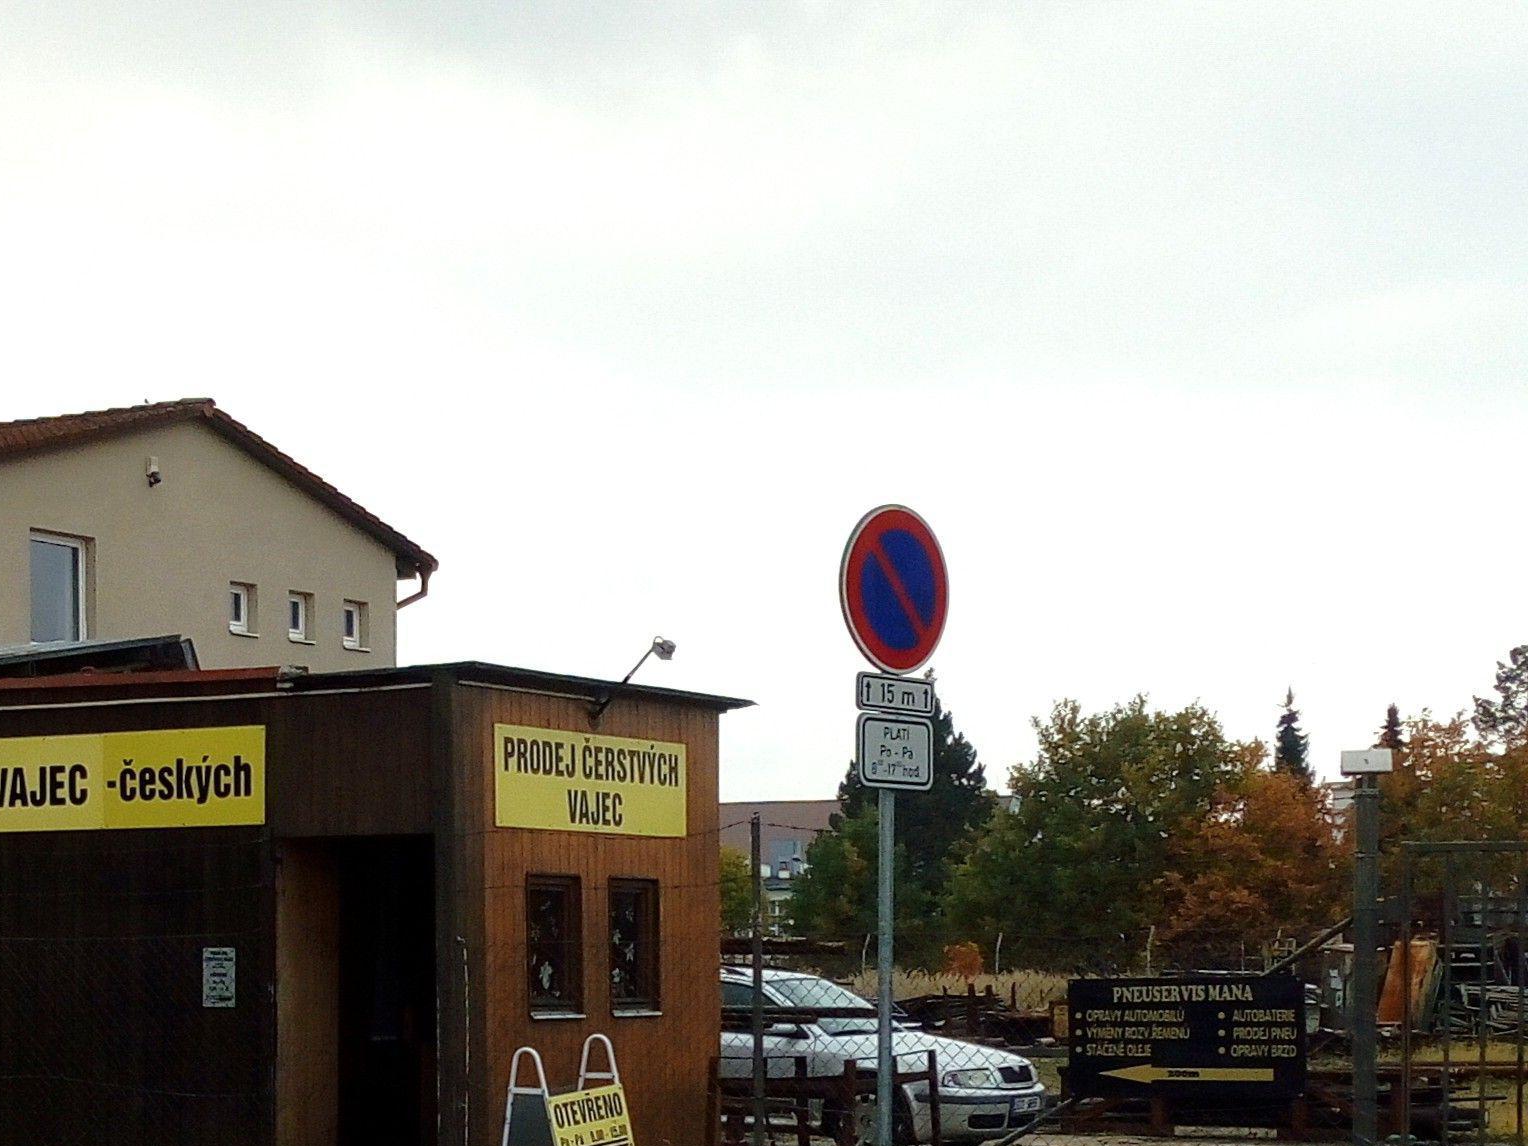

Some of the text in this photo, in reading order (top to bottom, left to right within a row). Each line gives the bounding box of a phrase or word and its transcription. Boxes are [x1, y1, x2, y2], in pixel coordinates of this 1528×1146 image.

[880, 683, 915, 706] 15 m
[880, 744, 892, 758] Po
[504, 736, 679, 787] PRODEJ ČERSTVÝCH
[567, 789, 623, 827] VAJEC
[1113, 984, 1254, 1003] PNEUSERVIS MANA
[1085, 1009, 1122, 1022] OPRAVY
[1232, 1009, 1295, 1022] AUTOBATERIE
[1233, 1027, 1269, 1040] PRODEJ
[1230, 1045, 1269, 1057] OPRAVY
[554, 1092, 623, 1129] OTEVŘENO
